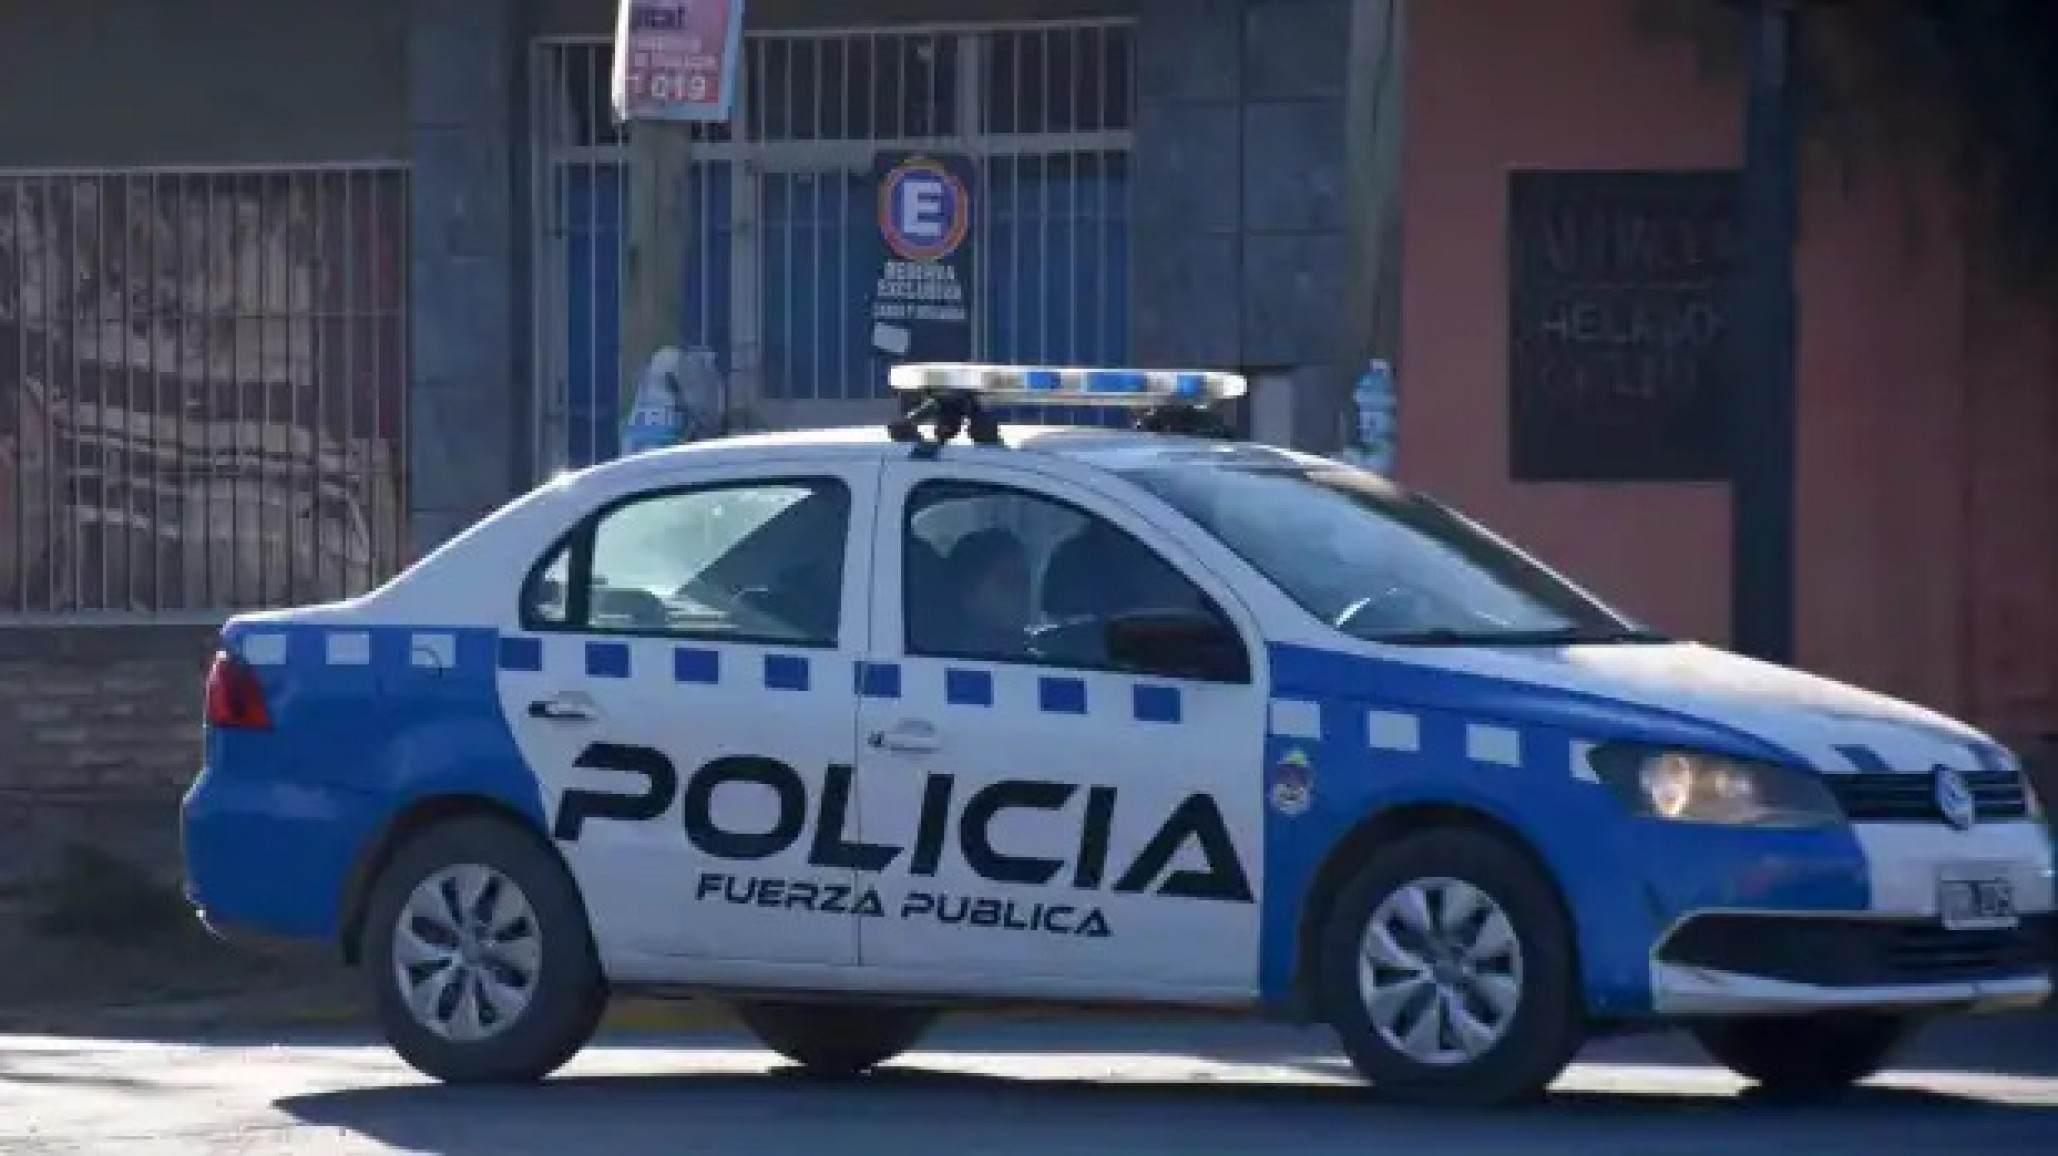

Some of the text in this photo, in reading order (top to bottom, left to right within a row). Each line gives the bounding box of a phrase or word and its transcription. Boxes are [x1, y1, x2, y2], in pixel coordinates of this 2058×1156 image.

[903, 181, 942, 236] E
[554, 741, 1255, 904] POLICIA
[697, 873, 1112, 938] FUERZA PUBLICA
